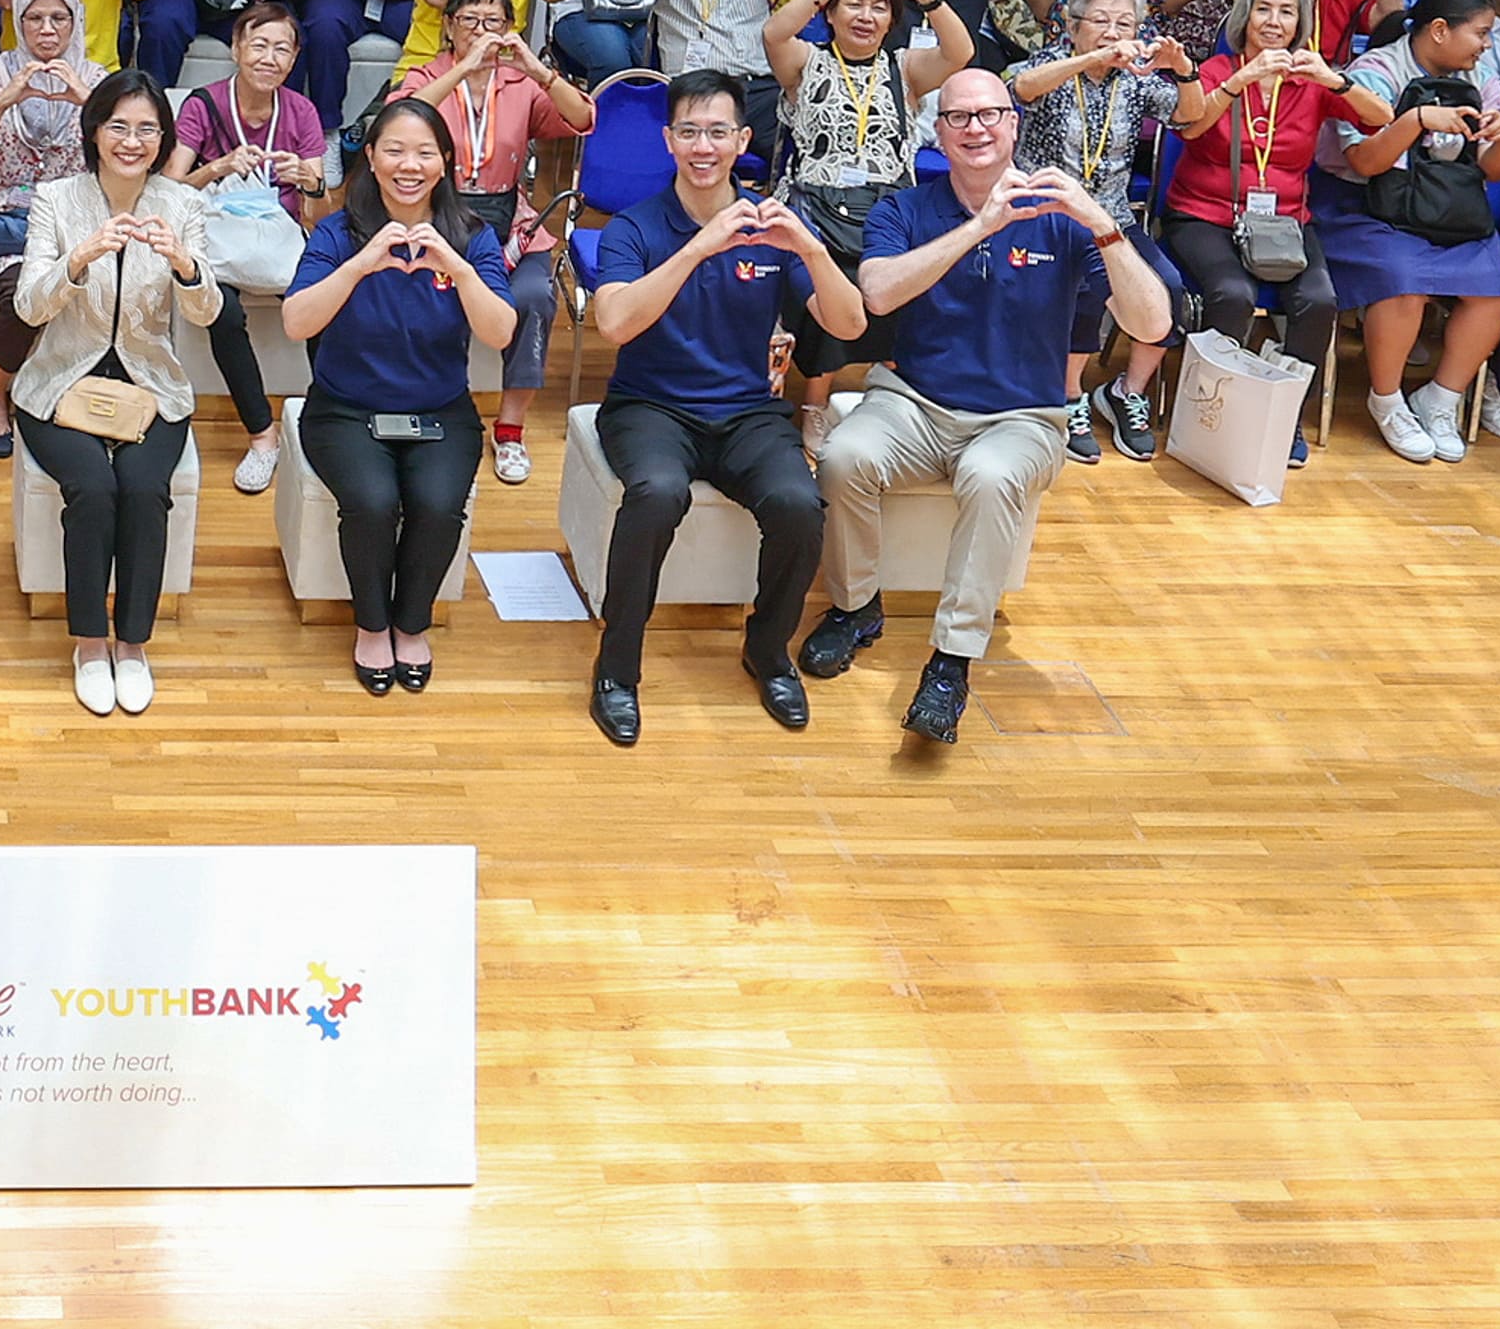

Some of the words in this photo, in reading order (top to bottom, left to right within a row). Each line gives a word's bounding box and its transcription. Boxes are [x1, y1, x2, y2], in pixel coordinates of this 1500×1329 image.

[50, 987, 301, 1018] YOUTHBANK
[15, 1052, 65, 1073] from
[71, 1052, 106, 1073] the
[112, 1052, 176, 1074] heart,
[9, 1084, 46, 1104] not
[51, 1083, 113, 1104] worth
[119, 1083, 198, 1107] doing...
